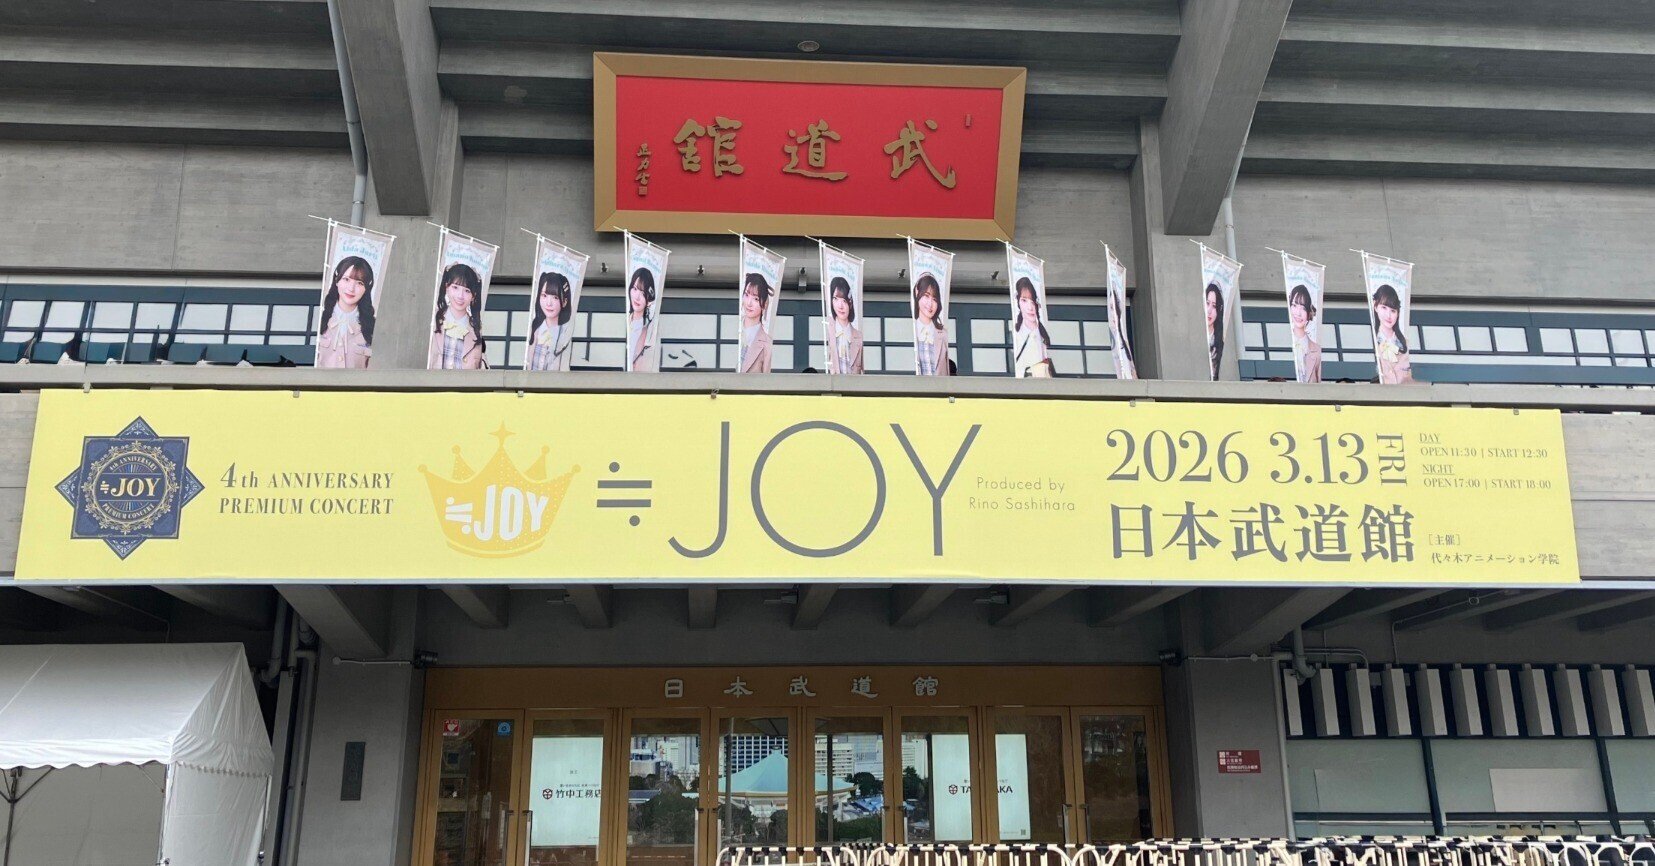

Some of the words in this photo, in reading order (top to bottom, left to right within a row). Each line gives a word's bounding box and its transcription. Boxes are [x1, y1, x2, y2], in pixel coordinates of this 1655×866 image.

[673, 116, 957, 190] 武道館
[1419, 432, 1442, 444] DAY
[1106, 429, 1249, 484] 2026
[1270, 431, 1370, 486] 3.13
[1376, 431, 1408, 487] FRI
[1420, 447, 1449, 457] OPEN
[1450, 448, 1477, 457] 11:30
[1487, 448, 1519, 458] START
[1521, 448, 1549, 459] 12:30
[219, 462, 259, 489] 4th
[267, 472, 394, 489] ANNIVERSARY
[1422, 464, 1456, 475] NIGHT
[976, 476, 1042, 491] Produced
[1048, 477, 1065, 494] by
[1424, 478, 1452, 488] OPEN
[1453, 479, 1481, 488] 17:00
[1491, 479, 1522, 489] START
[1525, 480, 1552, 490] 18:00
[219, 497, 304, 515] PREMIUM
[308, 496, 394, 515] CONCERT
[968, 496, 1000, 511] Rino
[1005, 497, 1075, 512] Sashihara
[1111, 501, 1414, 563] 日本武道館
[1431, 552, 1560, 565] 代々木アニメーション学院
[664, 675, 939, 699] 日本武道館
